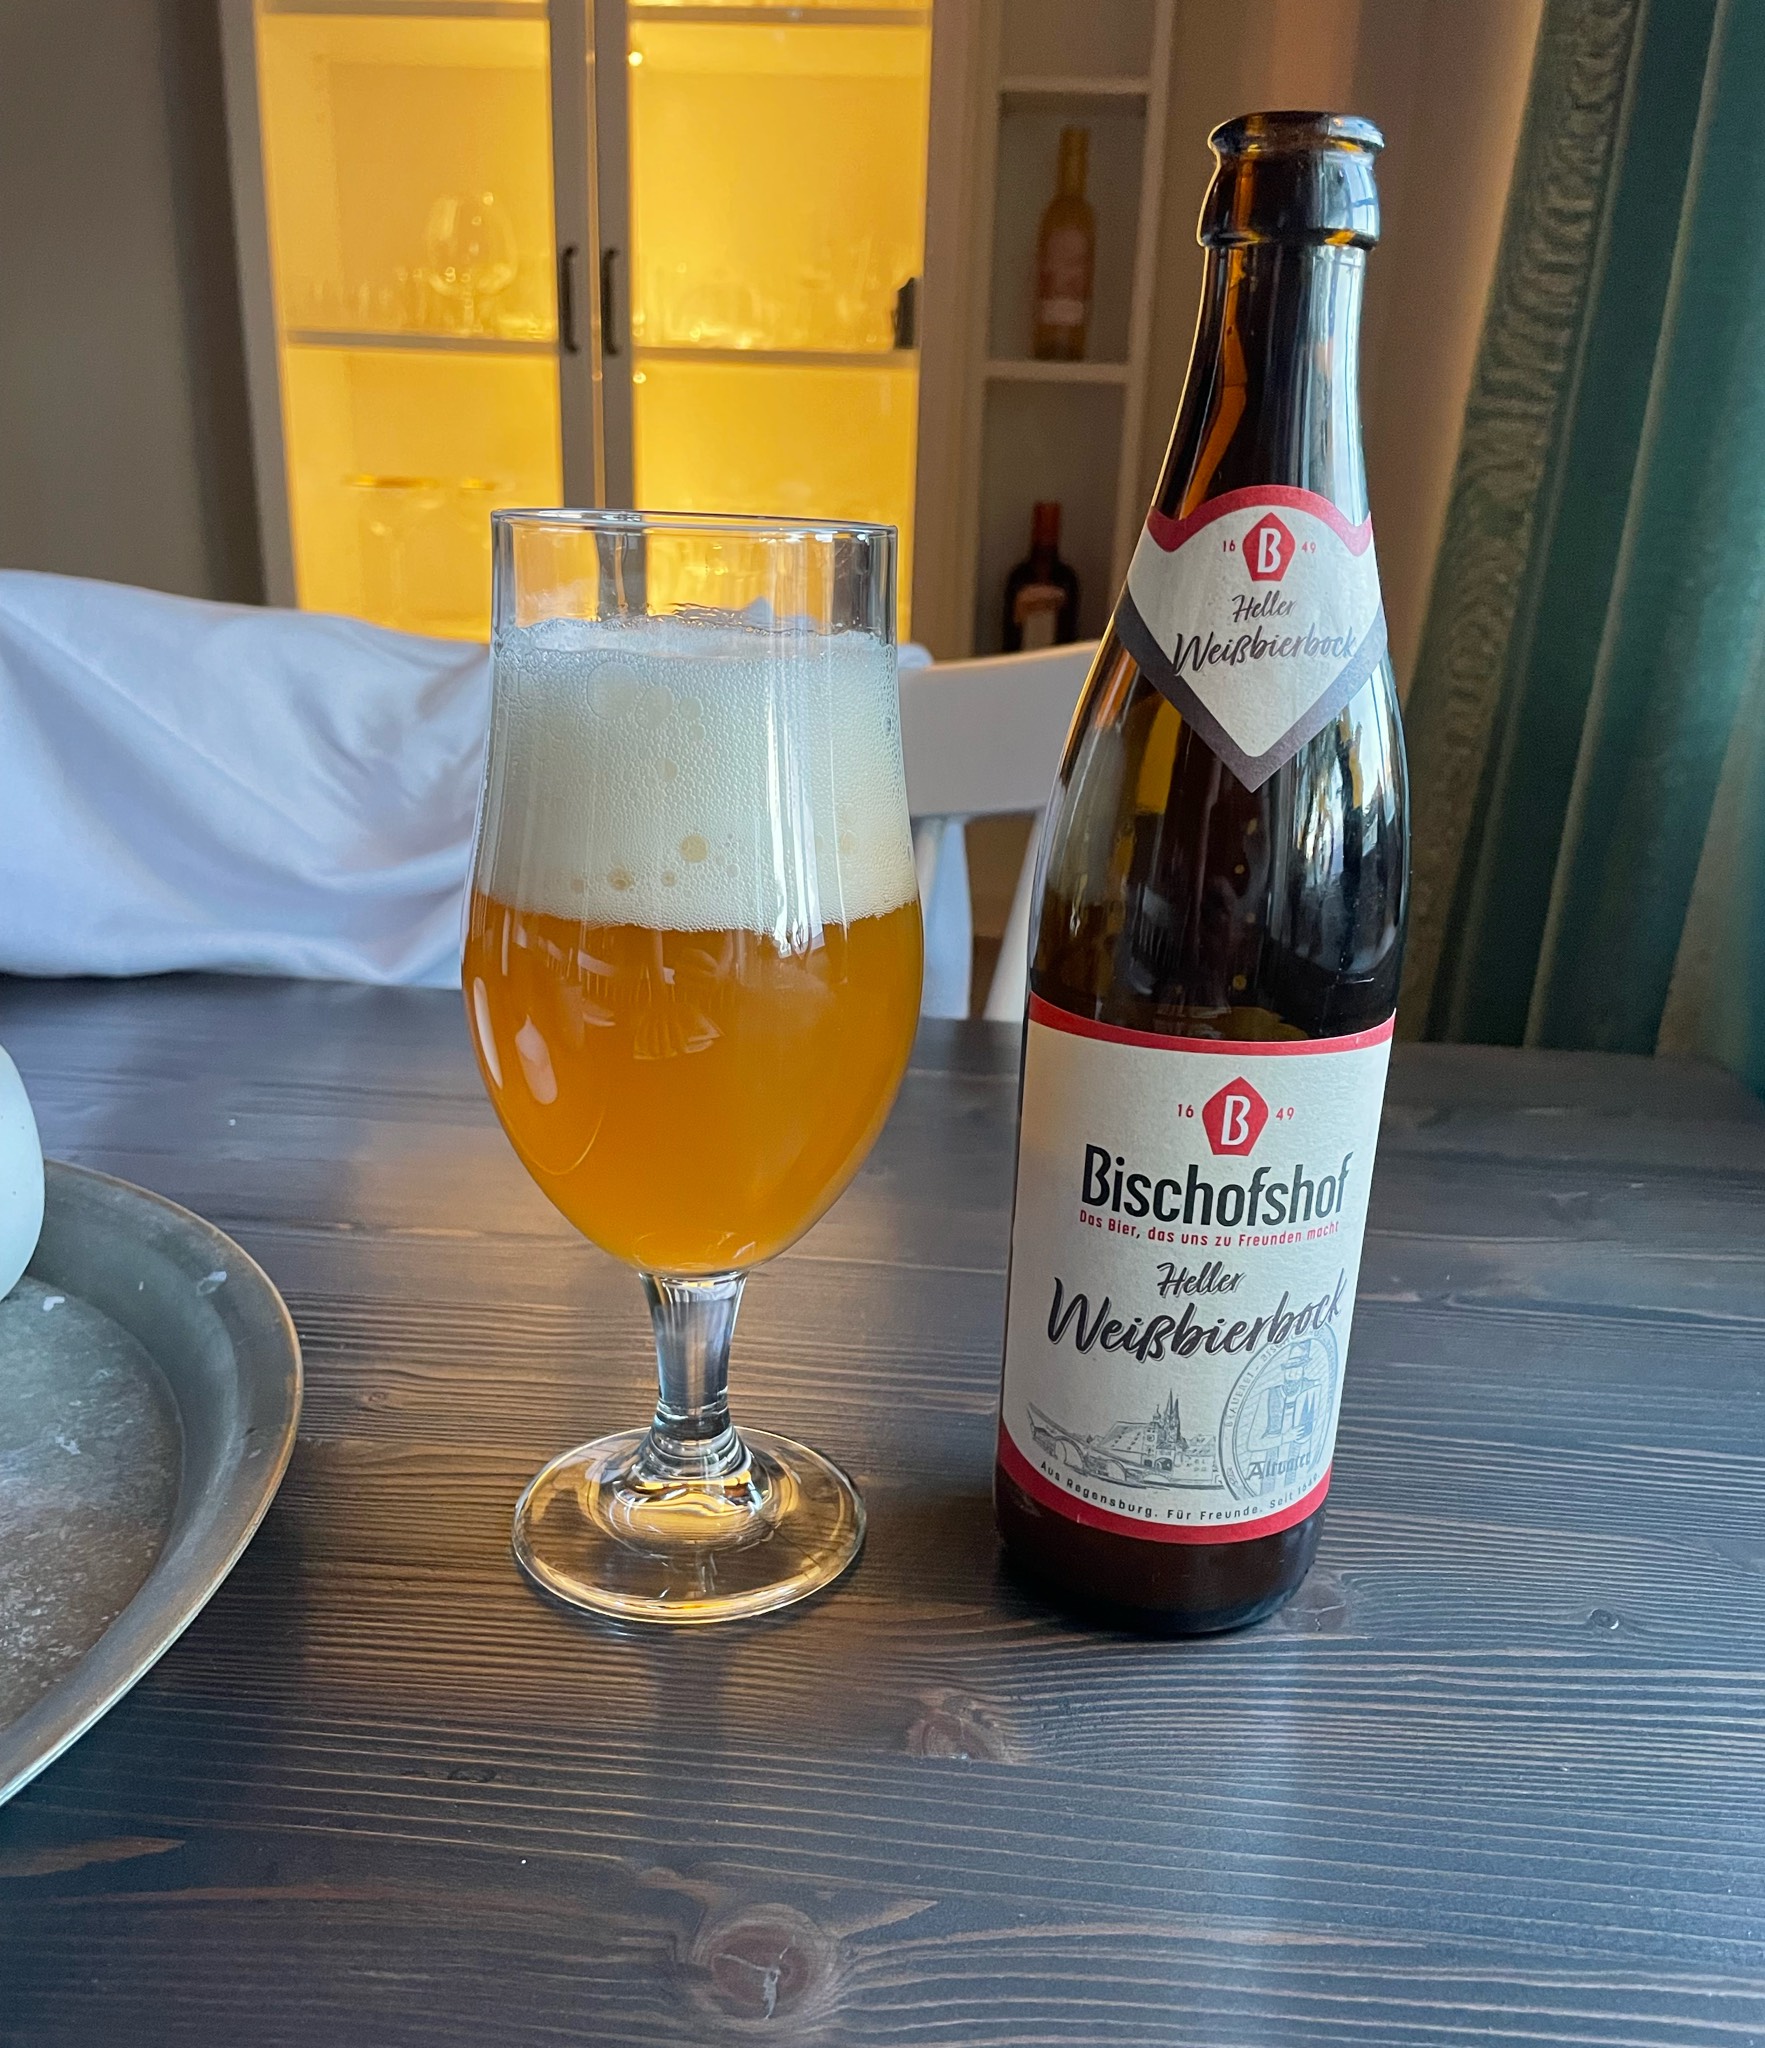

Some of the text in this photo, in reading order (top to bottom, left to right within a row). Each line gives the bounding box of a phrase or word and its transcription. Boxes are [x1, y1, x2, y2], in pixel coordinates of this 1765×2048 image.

[1223, 540, 1236, 552] 16
[1257, 527, 1283, 573] B
[1231, 590, 1297, 623] Heller
[1173, 623, 1356, 675] Weißbierbock
[1177, 1095, 1295, 1146] 16 B 49
[1081, 1143, 1354, 1227] Bischofshof
[1080, 1209, 1339, 1247] Das Bier, das uns zu Freunden macht
[1156, 1260, 1247, 1298] Heller
[1047, 1267, 1348, 1363] Weißbierbock
[1040, 1461, 1061, 1482] Aus
[1066, 1479, 1158, 1519] Regensburg.
[1167, 1509, 1192, 1521] Für
[1200, 1505, 1264, 1521] Freunde.
[1269, 1491, 1293, 1509] Seit
